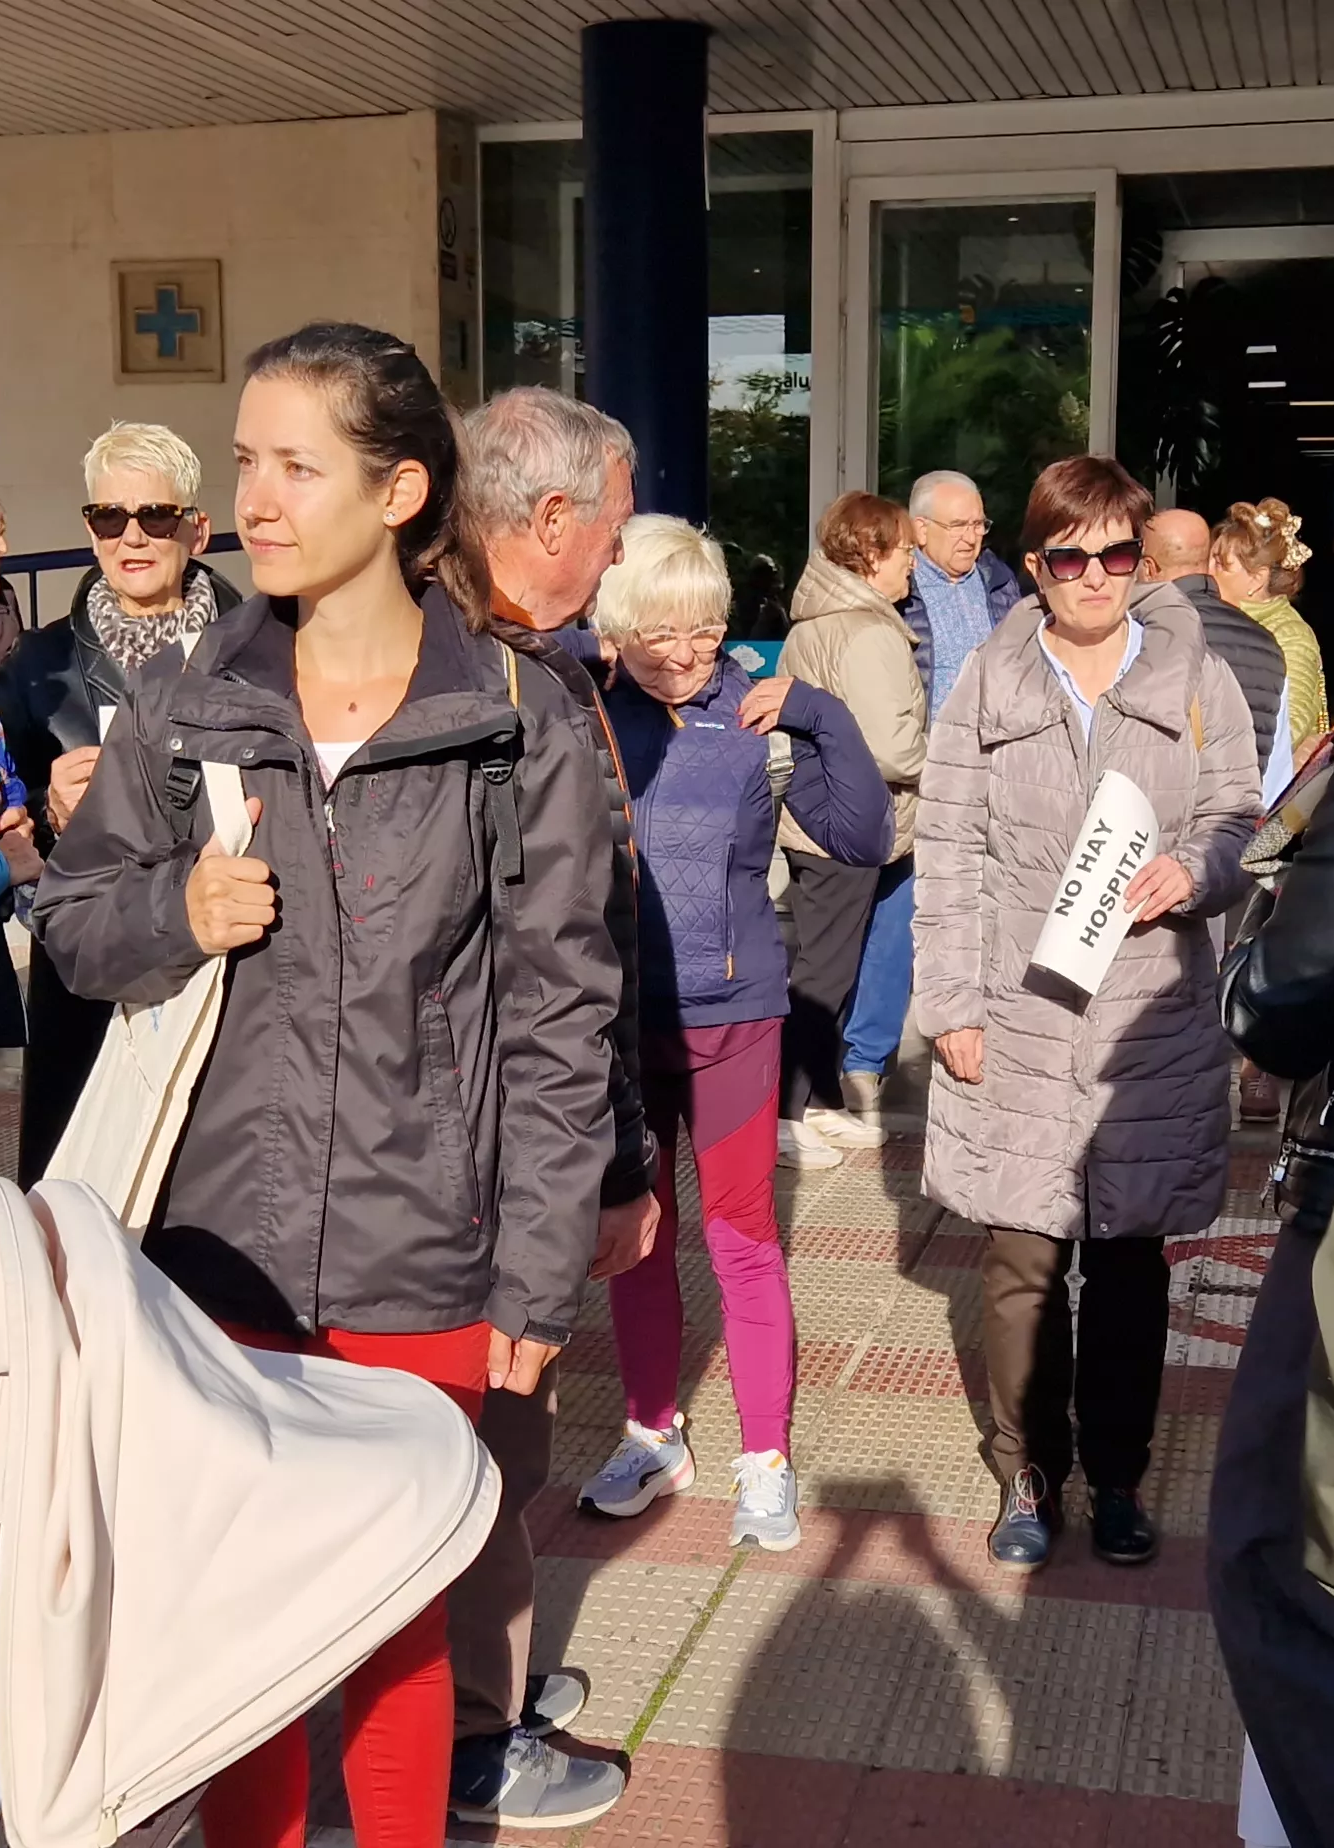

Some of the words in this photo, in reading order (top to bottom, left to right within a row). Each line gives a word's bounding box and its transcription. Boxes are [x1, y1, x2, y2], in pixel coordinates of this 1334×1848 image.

[1054, 879, 1083, 917] NO
[1075, 818, 1113, 873] HAY
[1079, 830, 1149, 948] HOSPITAL
